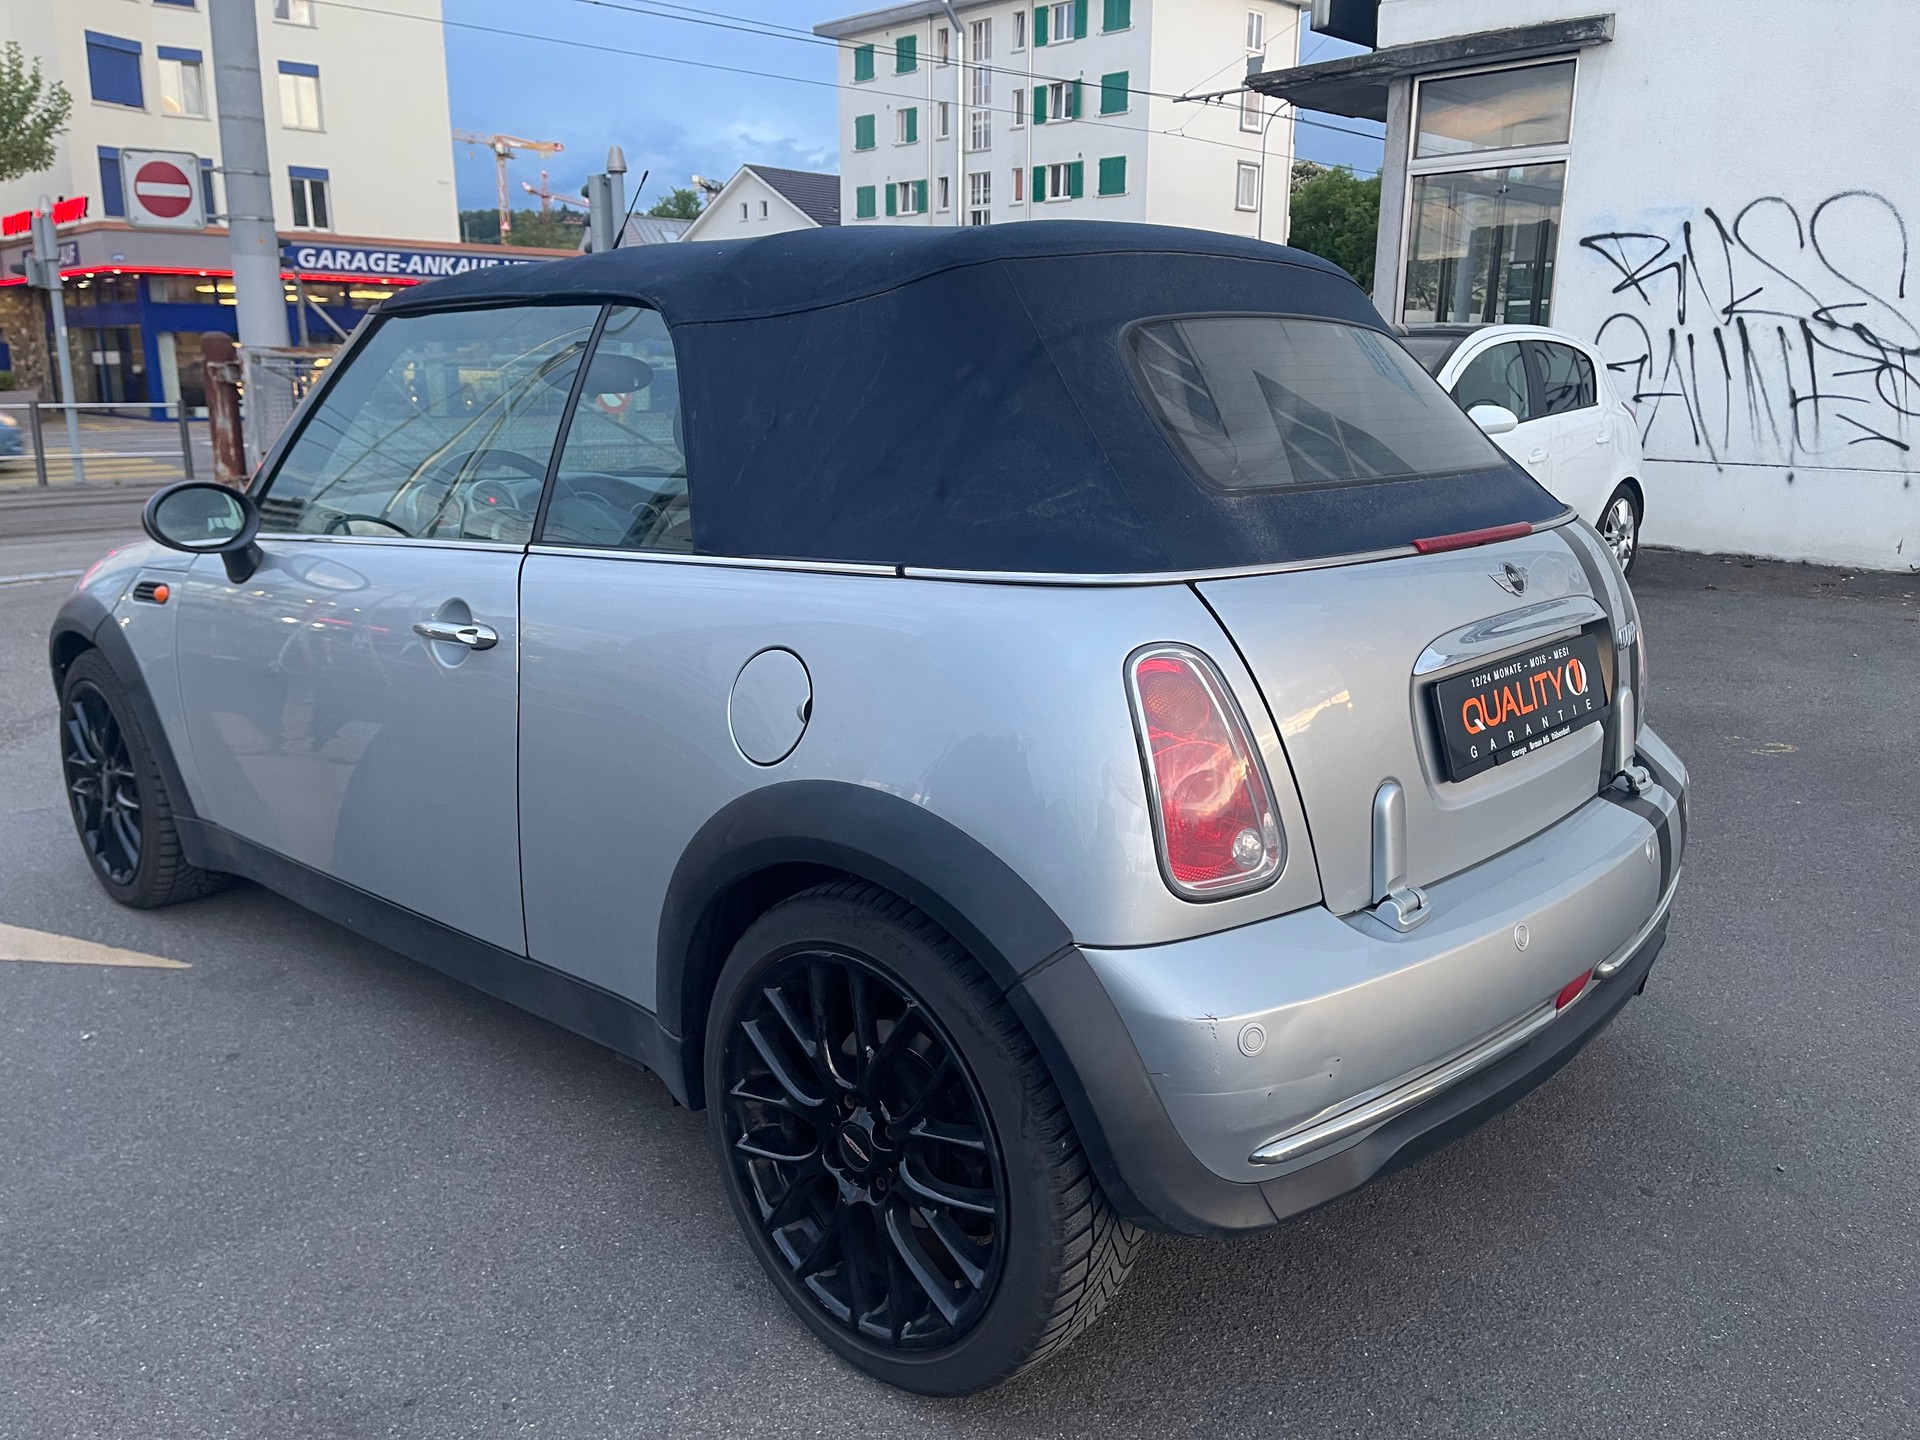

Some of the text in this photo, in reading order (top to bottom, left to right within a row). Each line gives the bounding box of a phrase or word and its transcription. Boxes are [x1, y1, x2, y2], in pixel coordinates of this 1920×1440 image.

[1471, 673, 1492, 688] 12/24
[1493, 662, 1523, 680] MONATE
[1529, 655, 1547, 669] MOIS
[1553, 646, 1570, 660] MESI
[1462, 666, 1562, 735] QUALITY
[1470, 698, 1593, 759] GARANTIE
